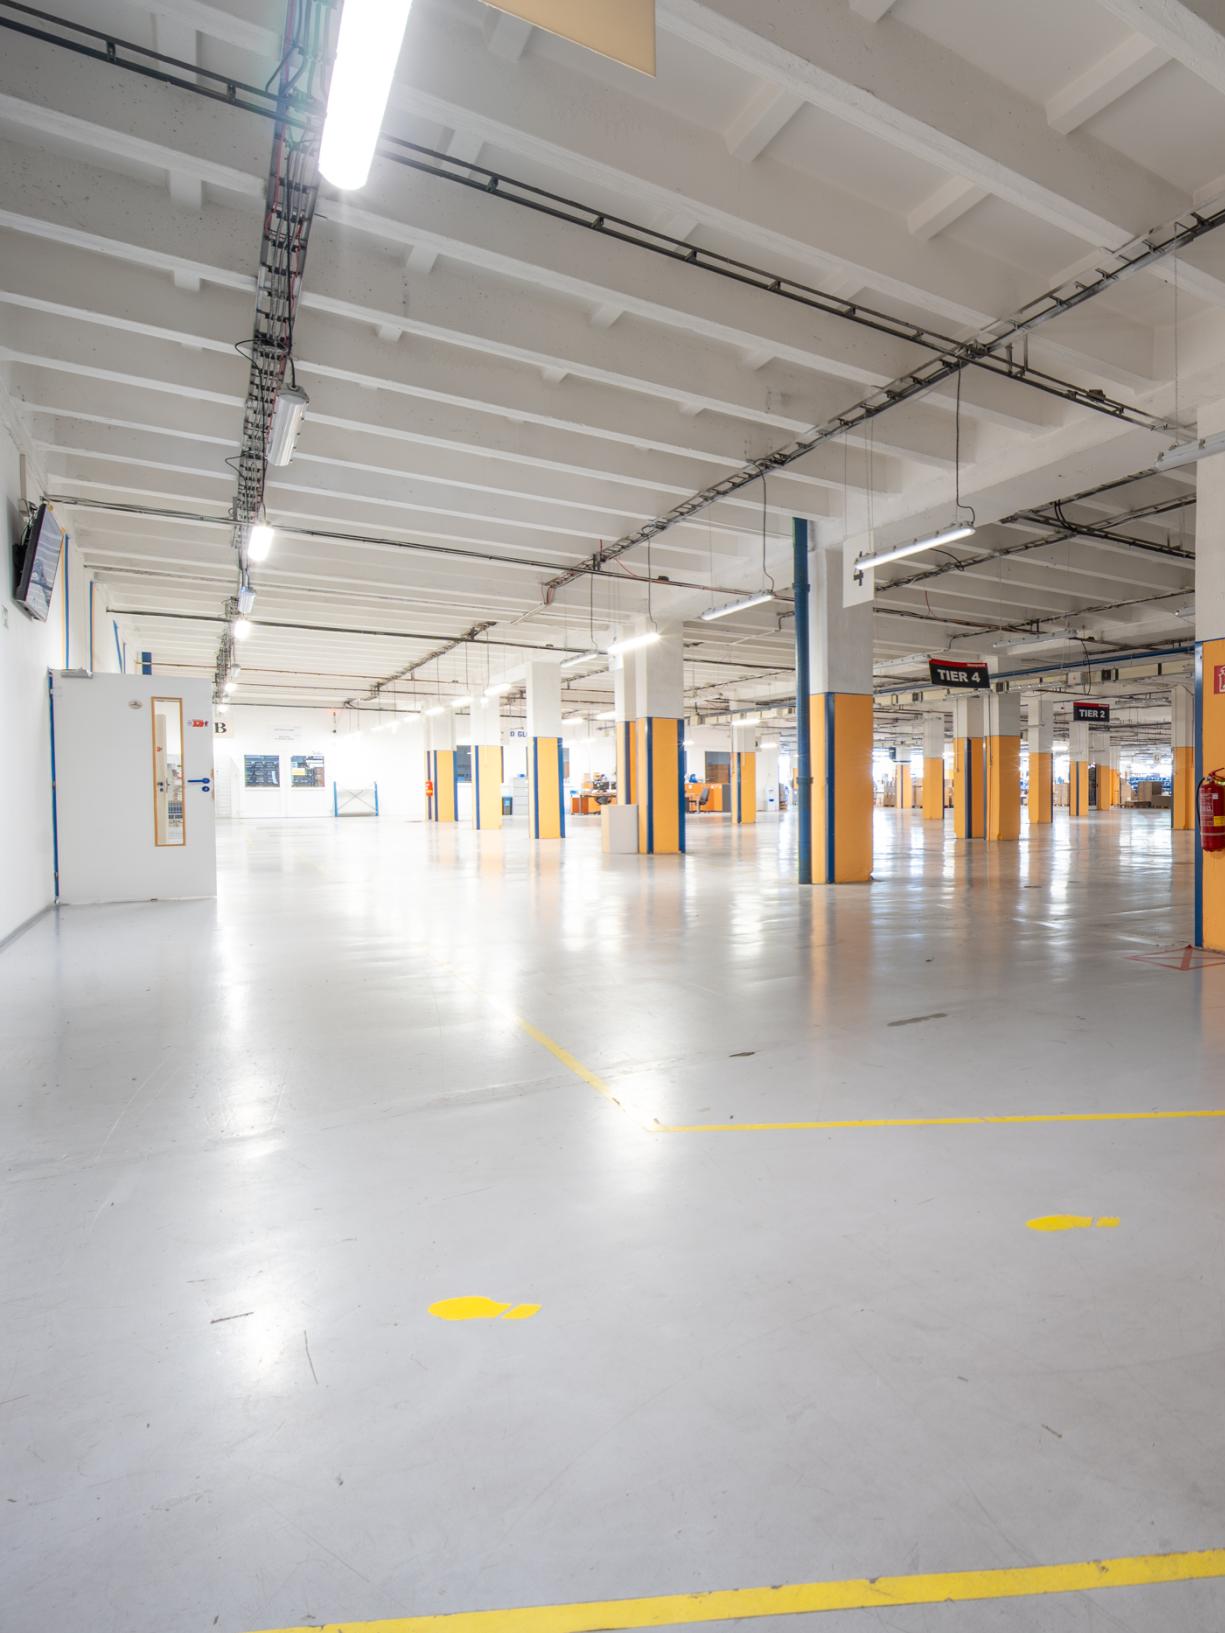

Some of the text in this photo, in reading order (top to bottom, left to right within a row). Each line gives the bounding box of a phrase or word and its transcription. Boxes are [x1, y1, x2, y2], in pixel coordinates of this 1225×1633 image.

[937, 668, 981, 683] TIER 4
[1079, 708, 1105, 718] TIER 2
[214, 722, 227, 733] B
